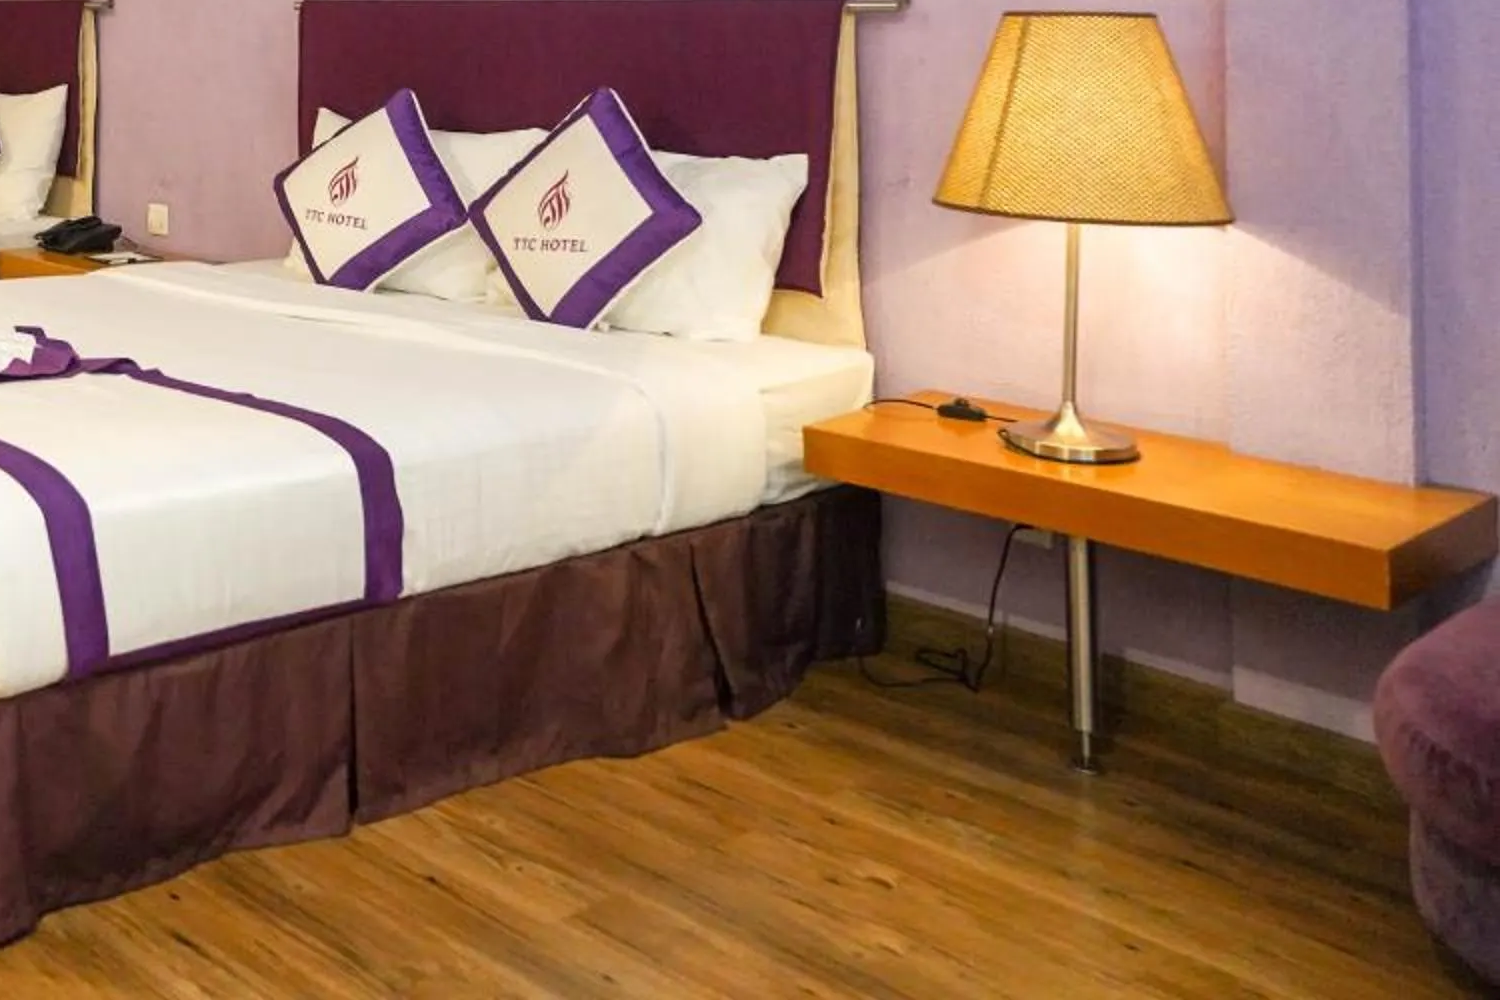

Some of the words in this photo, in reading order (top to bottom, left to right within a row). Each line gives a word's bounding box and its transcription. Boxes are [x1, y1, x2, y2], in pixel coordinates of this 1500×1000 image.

[305, 208, 325, 223] TTC
[327, 212, 368, 230] HOTEL
[513, 237, 537, 252] TTC
[541, 238, 588, 253] HOTEL
